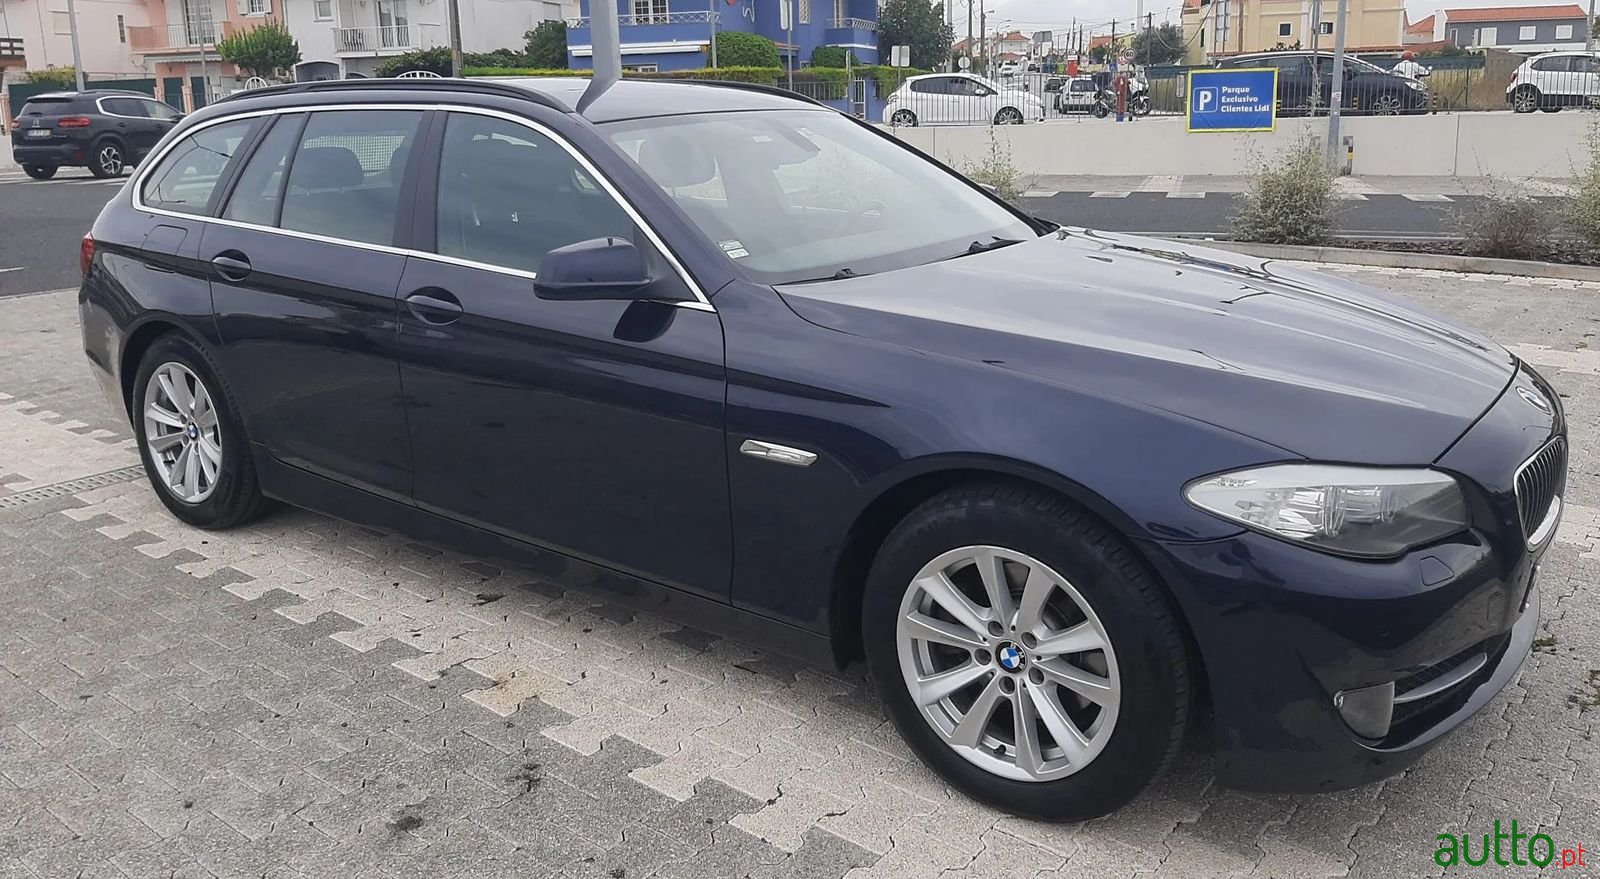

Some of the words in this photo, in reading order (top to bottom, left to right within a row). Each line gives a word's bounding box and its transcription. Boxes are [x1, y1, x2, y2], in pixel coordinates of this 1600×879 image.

[1222, 86, 1250, 94] Parque
[1199, 90, 1212, 111] P
[1221, 95, 1259, 103] Exclusivo
[1221, 105, 1253, 113] Clientes
[1254, 104, 1270, 112] Lidl
